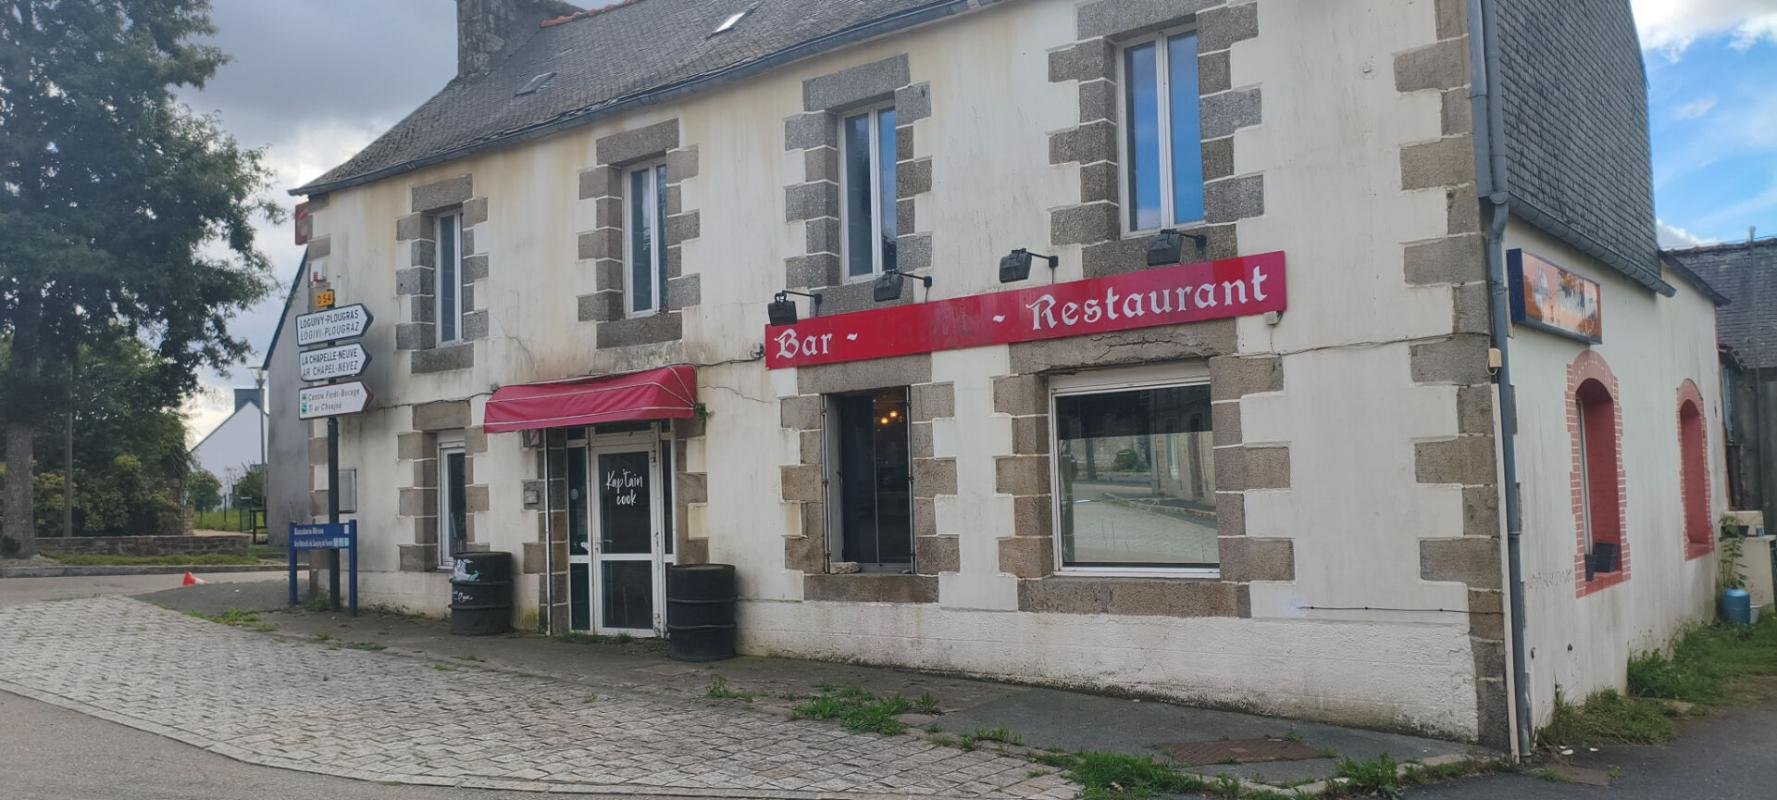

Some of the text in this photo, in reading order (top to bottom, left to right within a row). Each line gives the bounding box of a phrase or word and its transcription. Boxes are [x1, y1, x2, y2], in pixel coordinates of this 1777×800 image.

[300, 309, 359, 329] LOGUIVY-PLOUGRAS
[774, 328, 833, 359] Bar
[1025, 264, 1268, 331] Restaurant
[302, 348, 358, 366] LA CHAPELLE-NEUVE
[313, 360, 359, 376] CHAPEL-NEVEZ
[616, 489, 637, 506] cook
